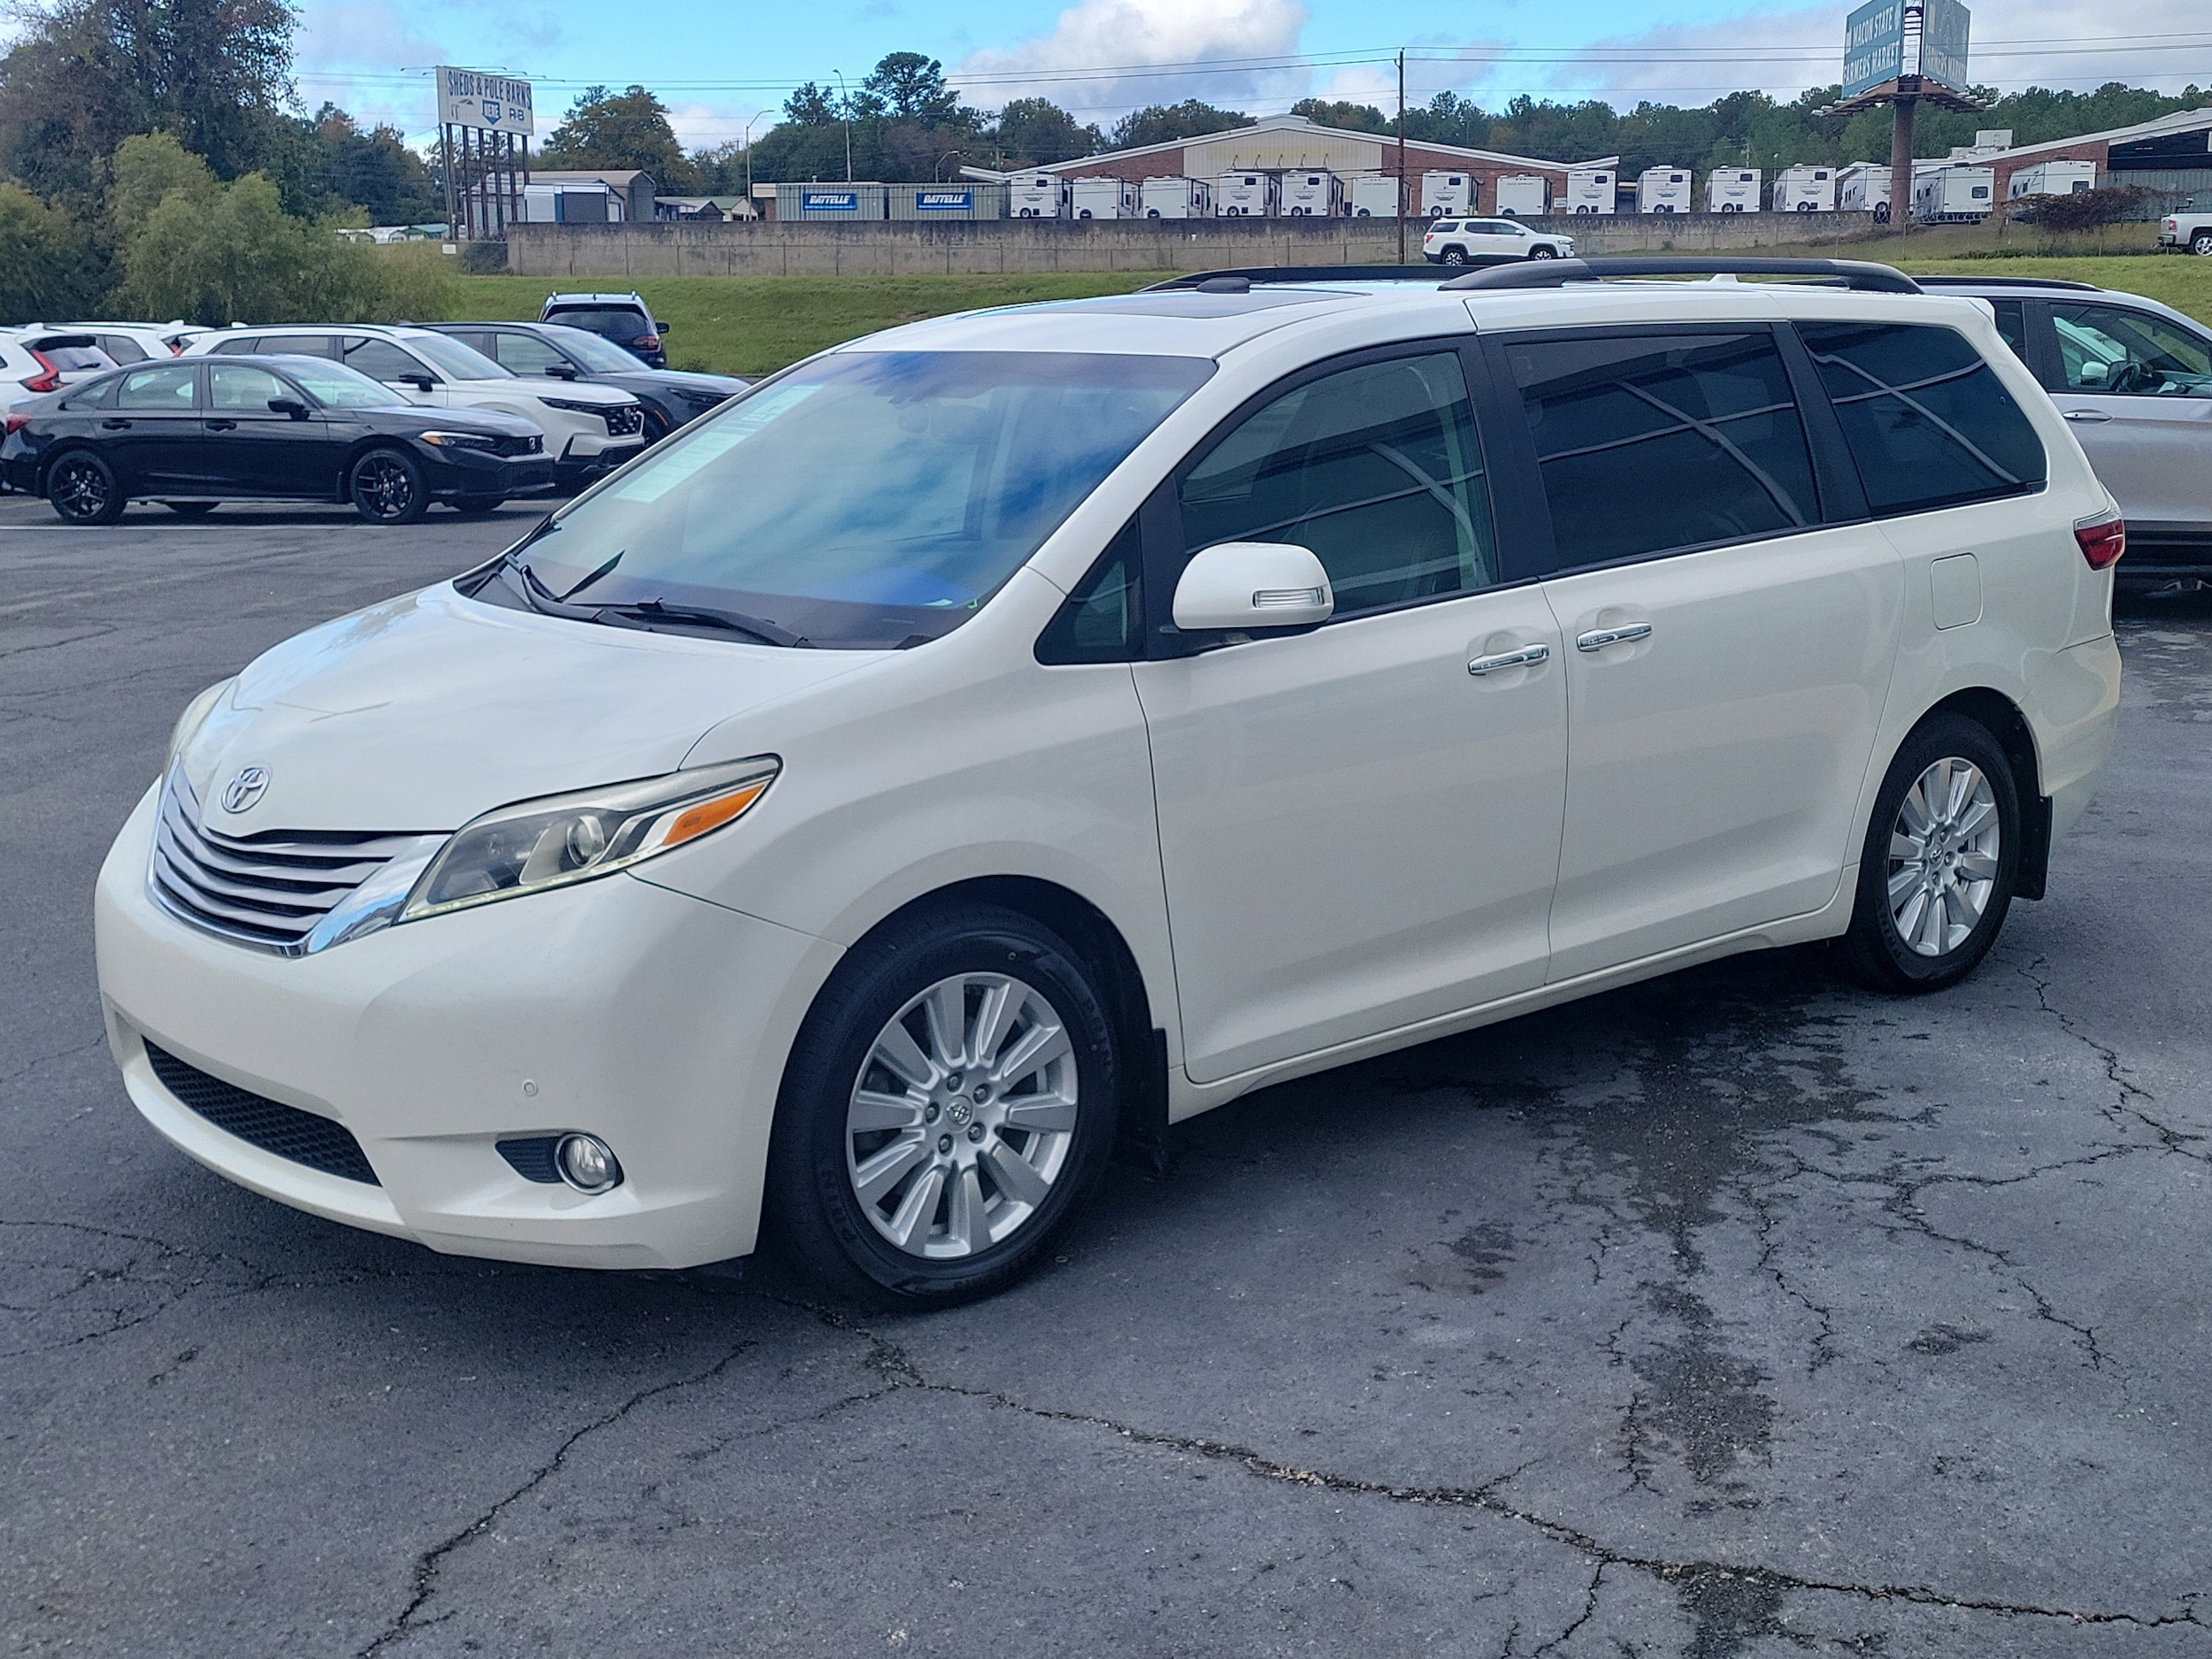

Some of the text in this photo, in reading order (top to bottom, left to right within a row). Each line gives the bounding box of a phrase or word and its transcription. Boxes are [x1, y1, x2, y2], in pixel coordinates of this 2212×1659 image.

[1853, 6, 1893, 50] MACON STATE
[1844, 40, 1900, 86] FARMERS MARKET
[448, 71, 531, 111] SHEDS & POLE BARNS
